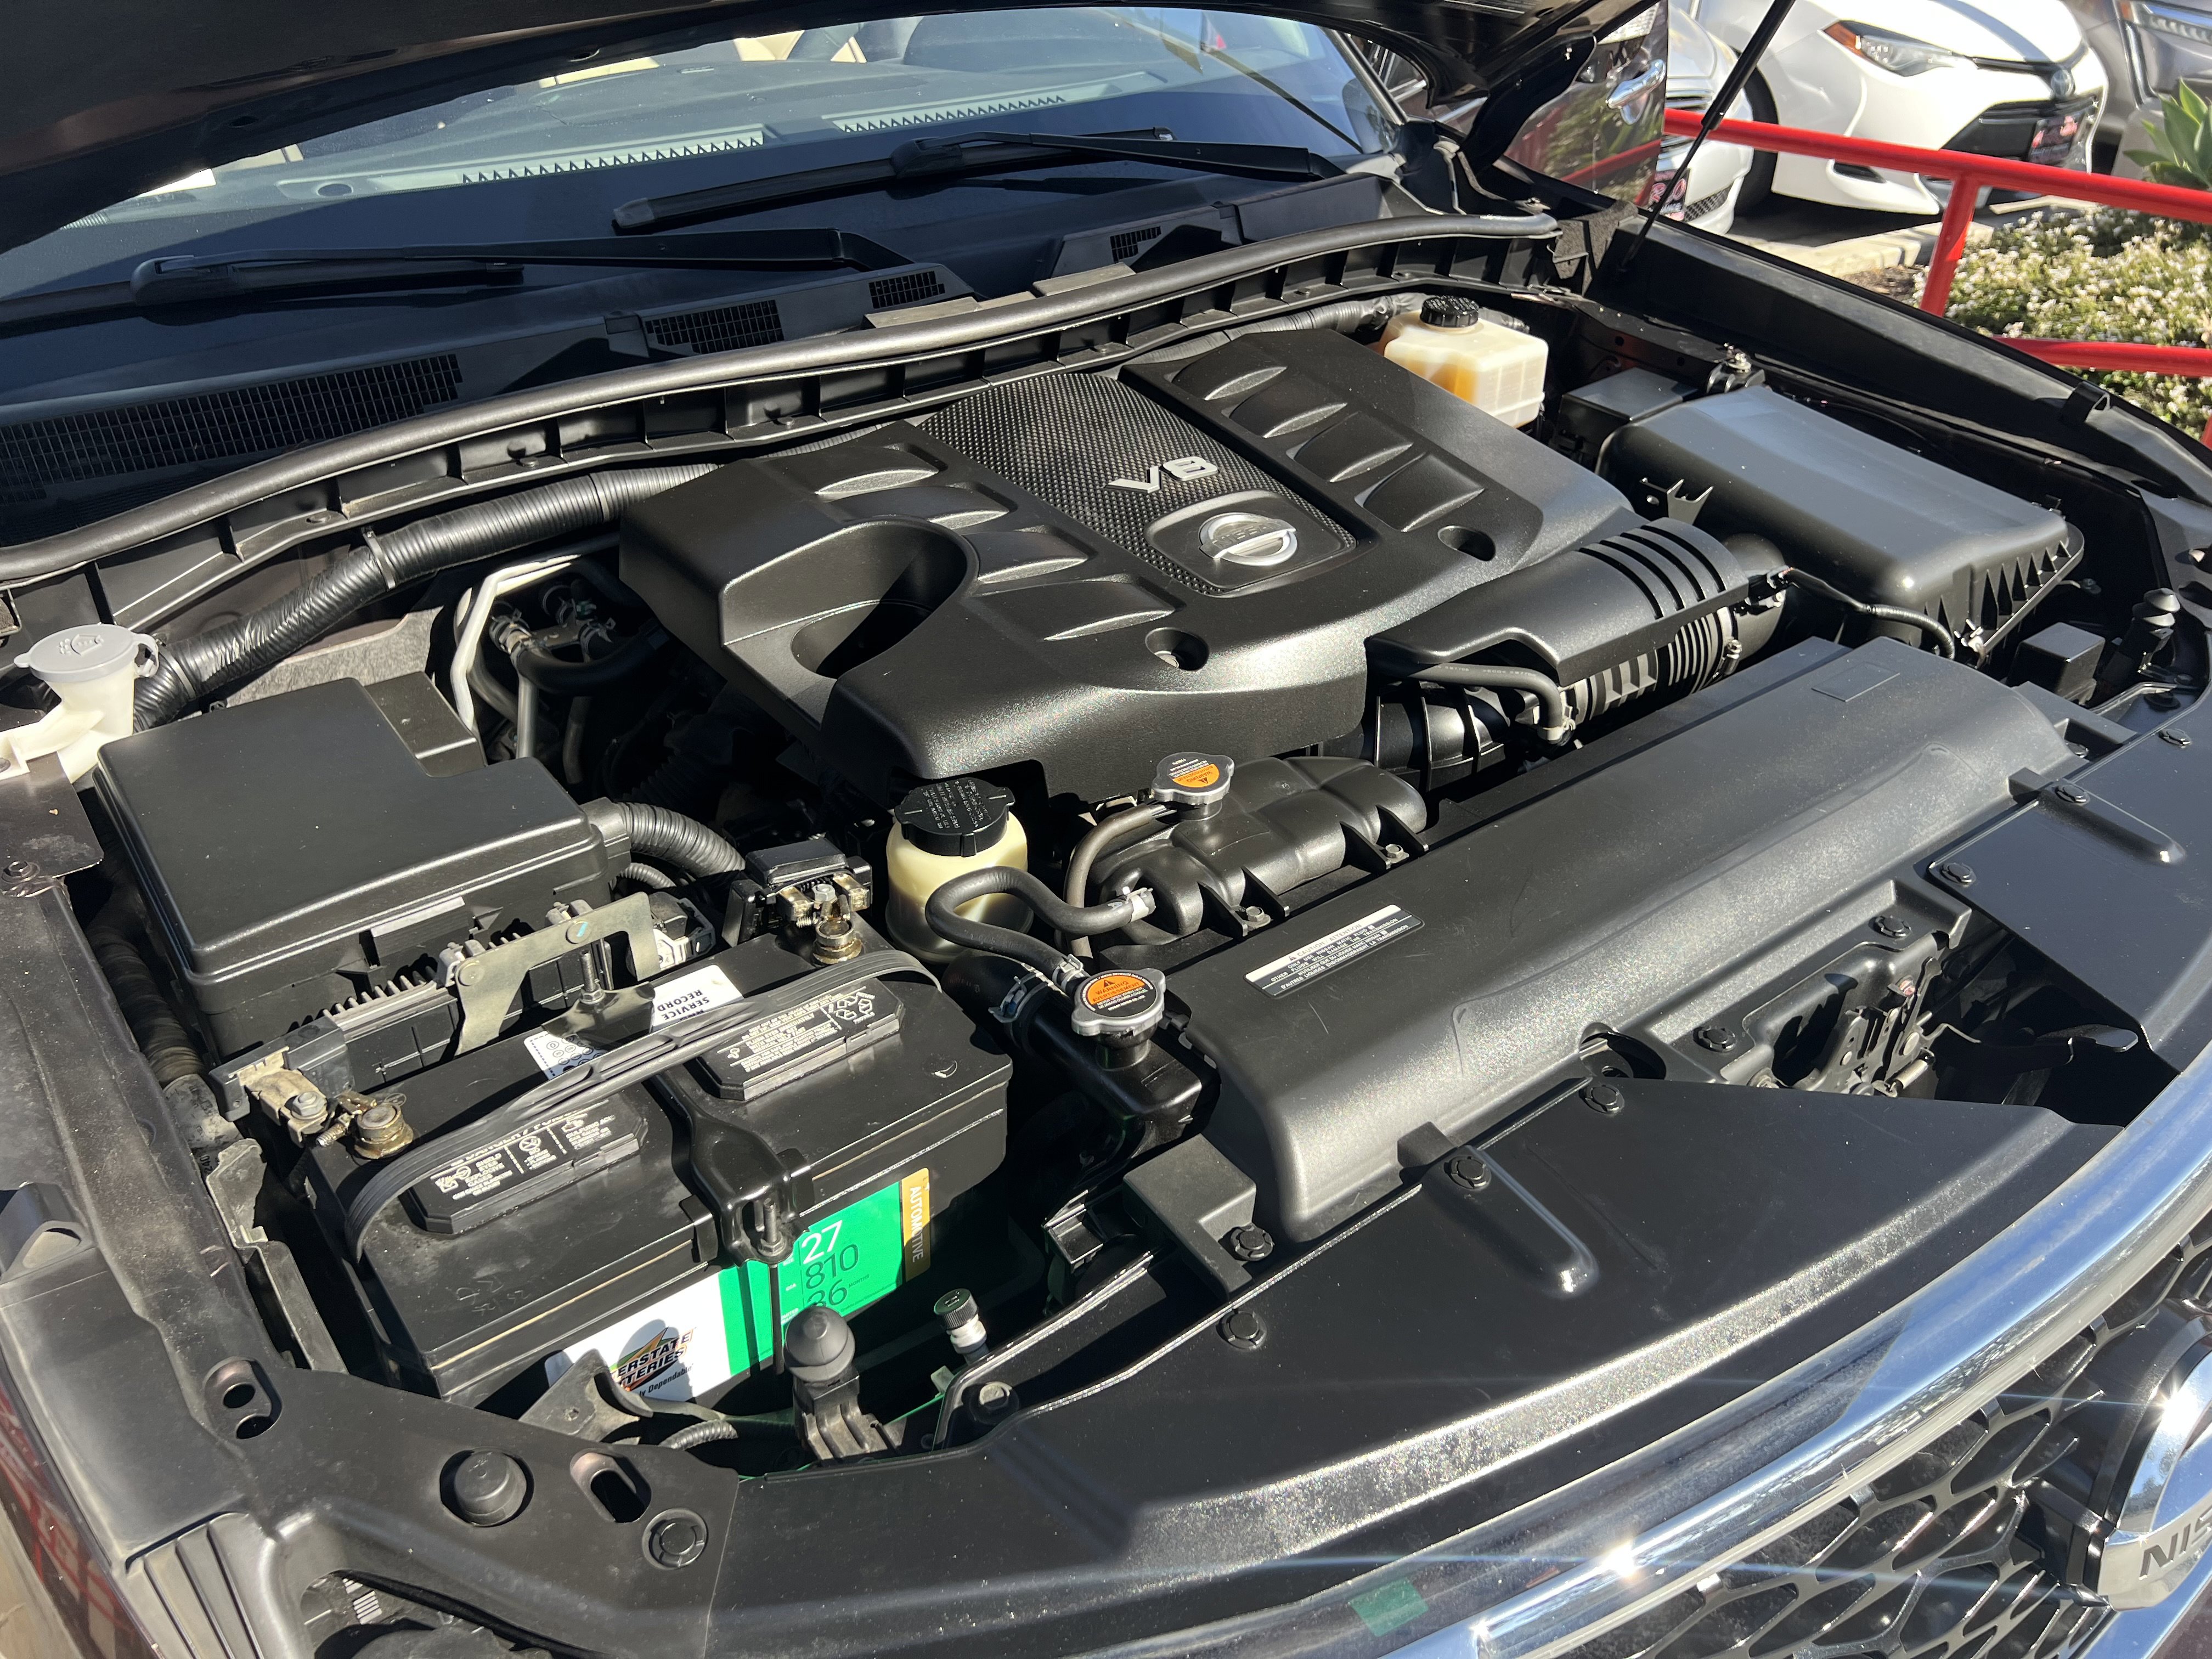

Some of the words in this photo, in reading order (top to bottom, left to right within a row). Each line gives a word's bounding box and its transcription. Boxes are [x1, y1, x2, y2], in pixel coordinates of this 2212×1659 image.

[1102, 456, 1218, 493] V8
[1212, 520, 1282, 549] NISSAN
[1296, 941, 1325, 956] CAUTION
[1329, 924, 1362, 940] ATTENTION
[1353, 928, 1368, 936] FLUID
[1270, 972, 1288, 981] OTHER
[1290, 962, 1309, 972] FLUIDS
[1327, 943, 1348, 953] DAMAGE
[657, 989, 703, 1011] RECORD
[1092, 982, 1139, 1001] AVERTISSEMENT
[1095, 980, 1128, 995] WARNING
[661, 997, 709, 1020] SERVICE
[910, 1186, 924, 1263] AUTOMOTIVE
[801, 1220, 843, 1264] 27
[805, 1243, 860, 1290] 810
[849, 1274, 870, 1289] MONTHS
[611, 1329, 693, 1376] ERSTATE
[618, 1344, 687, 1385] TERIES
[648, 1364, 693, 1393] Dependable
